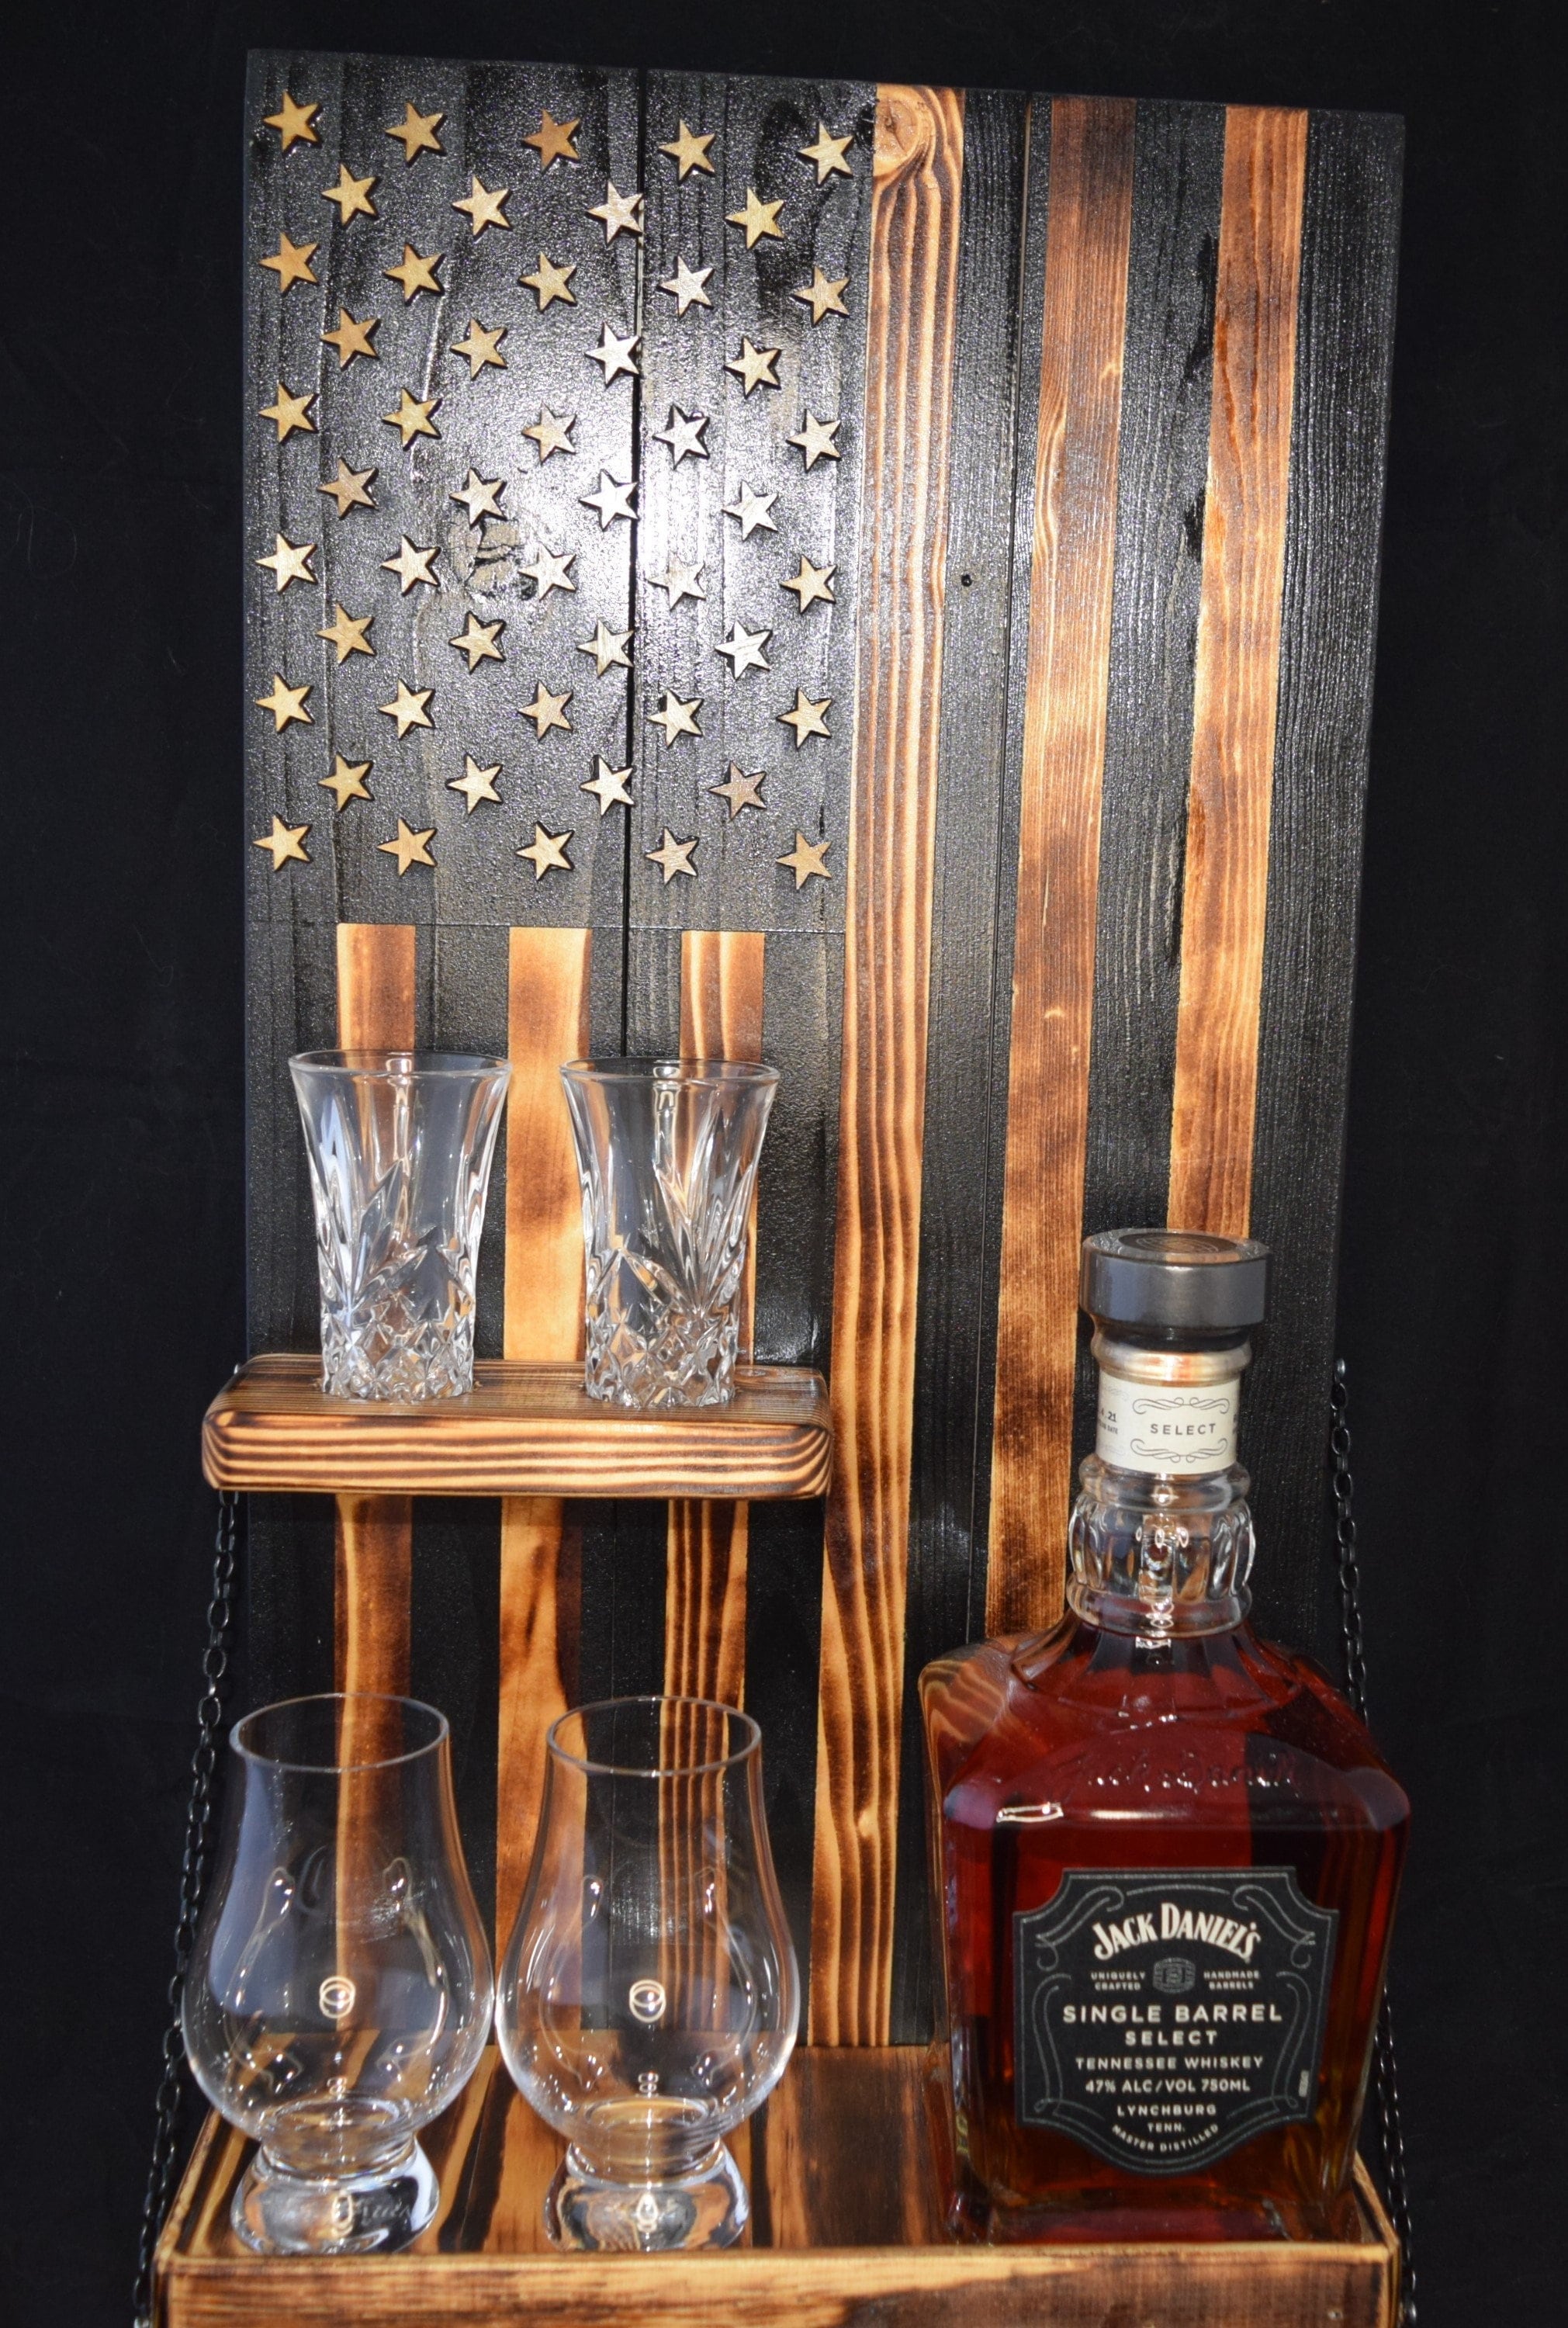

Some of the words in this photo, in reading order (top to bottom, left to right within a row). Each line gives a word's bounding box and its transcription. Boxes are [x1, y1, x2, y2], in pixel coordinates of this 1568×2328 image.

[1150, 1422, 1217, 1436] SELECT
[1092, 1912, 1158, 1961] JACK
[1091, 1971, 1146, 1980] UNIQUELY
[1203, 1969, 1260, 1980] HANDMADE
[1095, 1981, 1141, 1990] CRAFTED
[1209, 1980, 1254, 1990] BARRELS
[1063, 2004, 1162, 2023] SINGLE
[1175, 2004, 1282, 2022] BARREL
[1125, 2030, 1217, 2046] SELECT
[1075, 2056, 1177, 2070] TENNESSEE
[1184, 2056, 1264, 2069] WHISKEY
[1085, 2079, 1116, 2093] 47%
[1122, 2079, 1196, 2093] ALC/VOL
[1202, 2077, 1251, 2092] 750ML
[1116, 2104, 1217, 2117] LYNCHBURG
[1147, 2122, 1186, 2133] TENN.
[1112, 2123, 1154, 2152] MASTER
